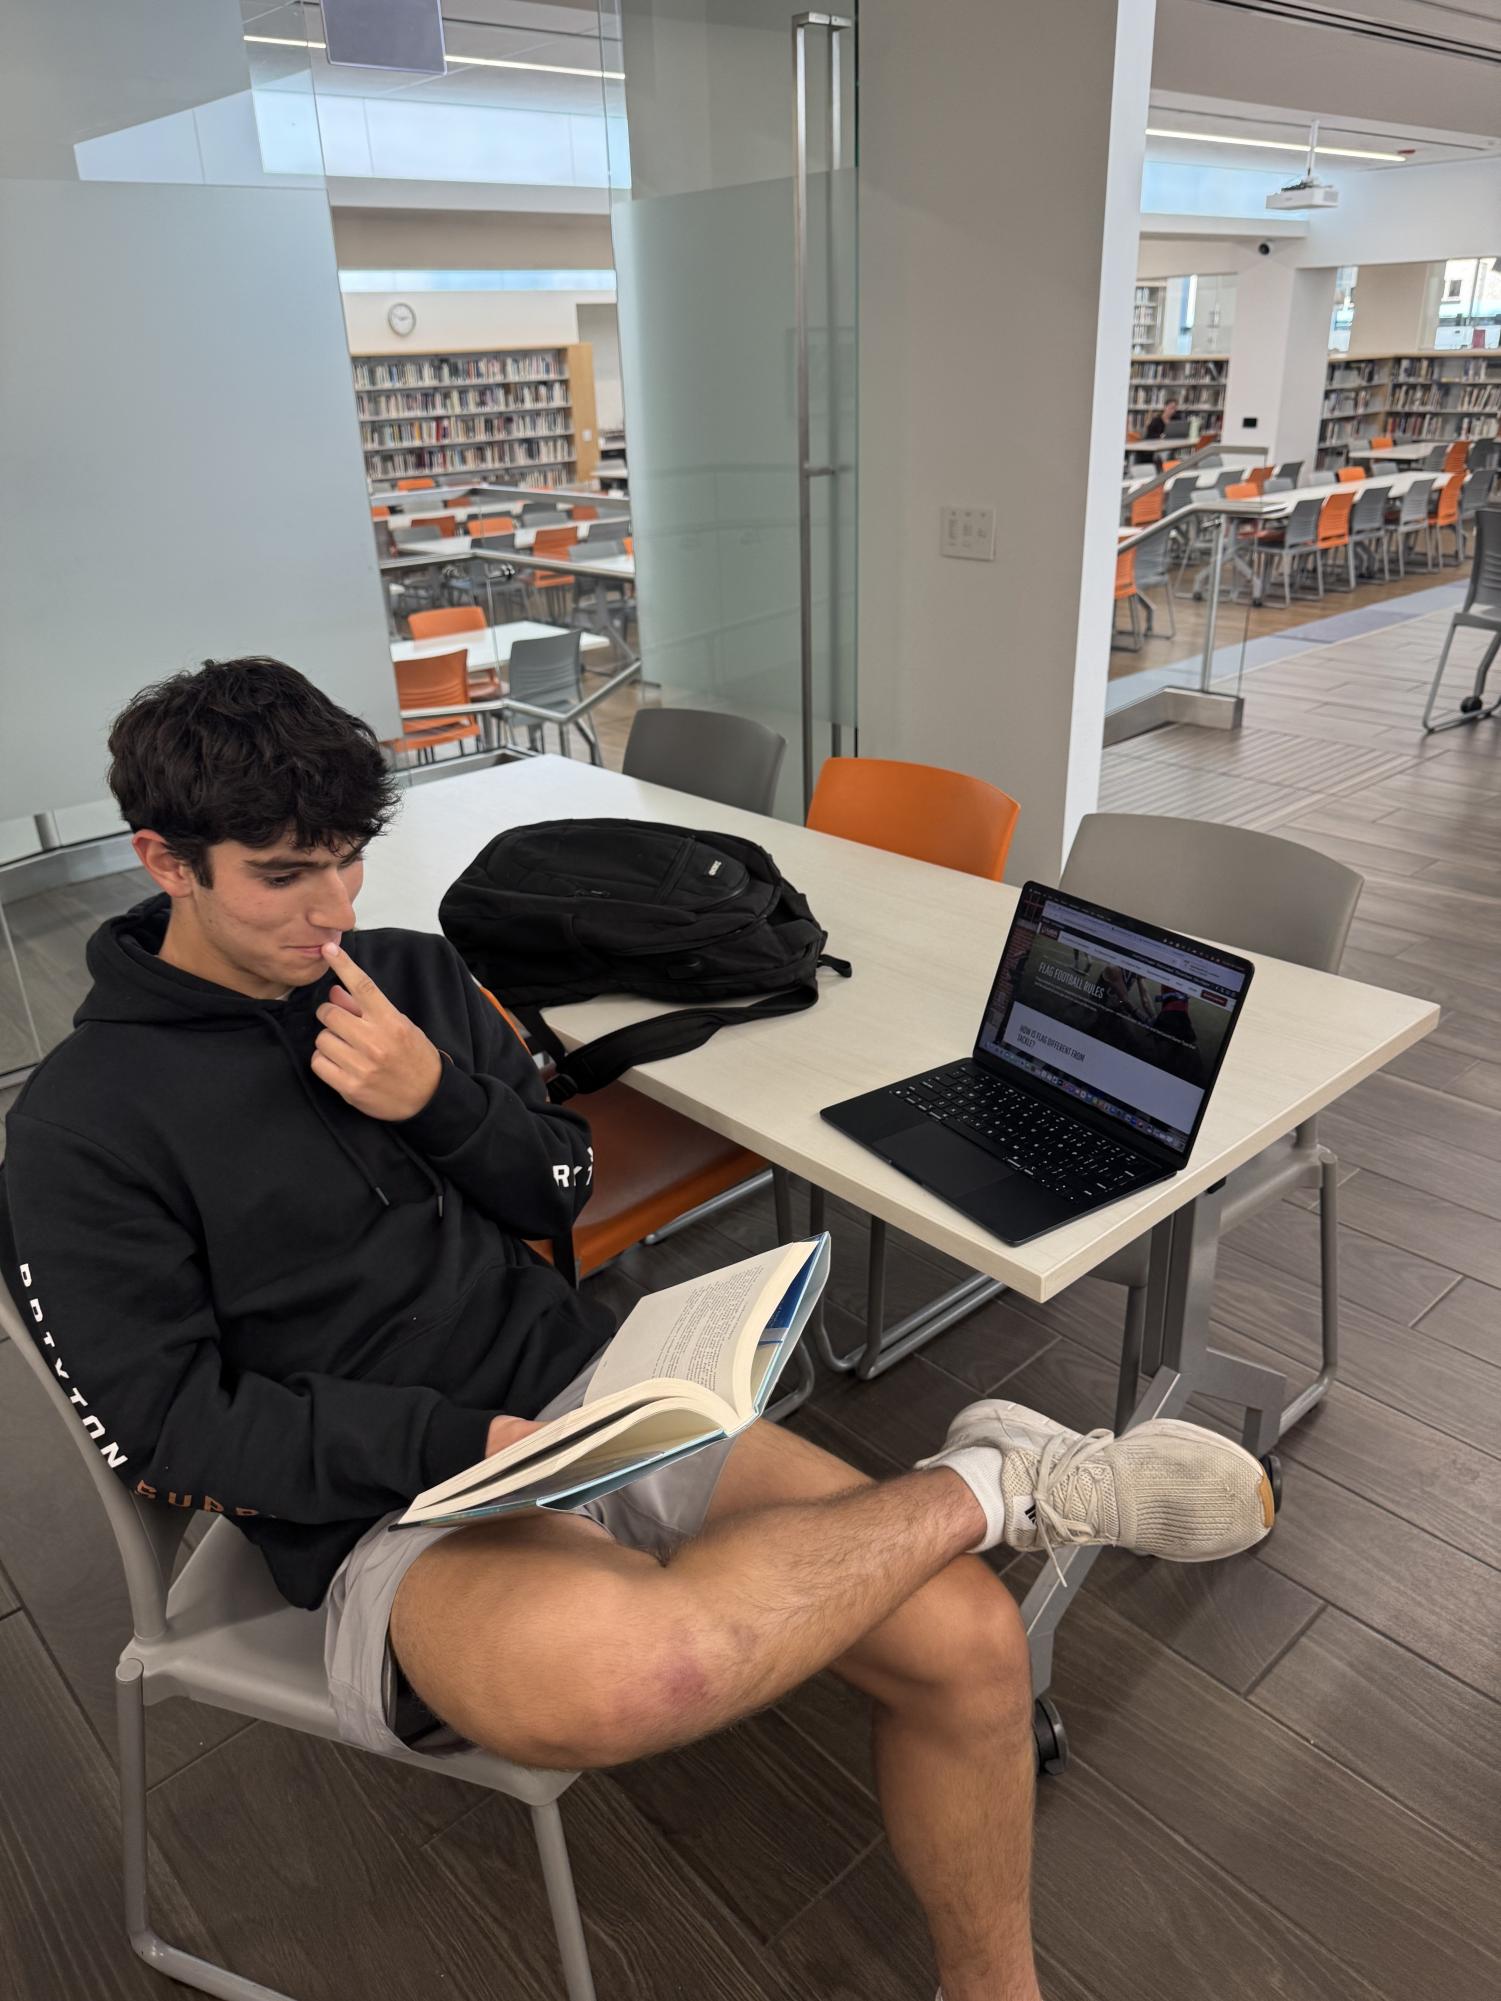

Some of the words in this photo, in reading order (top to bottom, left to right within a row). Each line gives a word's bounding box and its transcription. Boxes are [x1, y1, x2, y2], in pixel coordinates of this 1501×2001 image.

[1038, 962, 1053, 977] FLAG
[1054, 968, 1082, 990] FOOTBALL
[1083, 980, 1104, 999] RULES
[1036, 1031, 1048, 1043] FLAG
[1047, 1036, 1071, 1054] DIFFERENT
[1070, 1047, 1086, 1062] FROM
